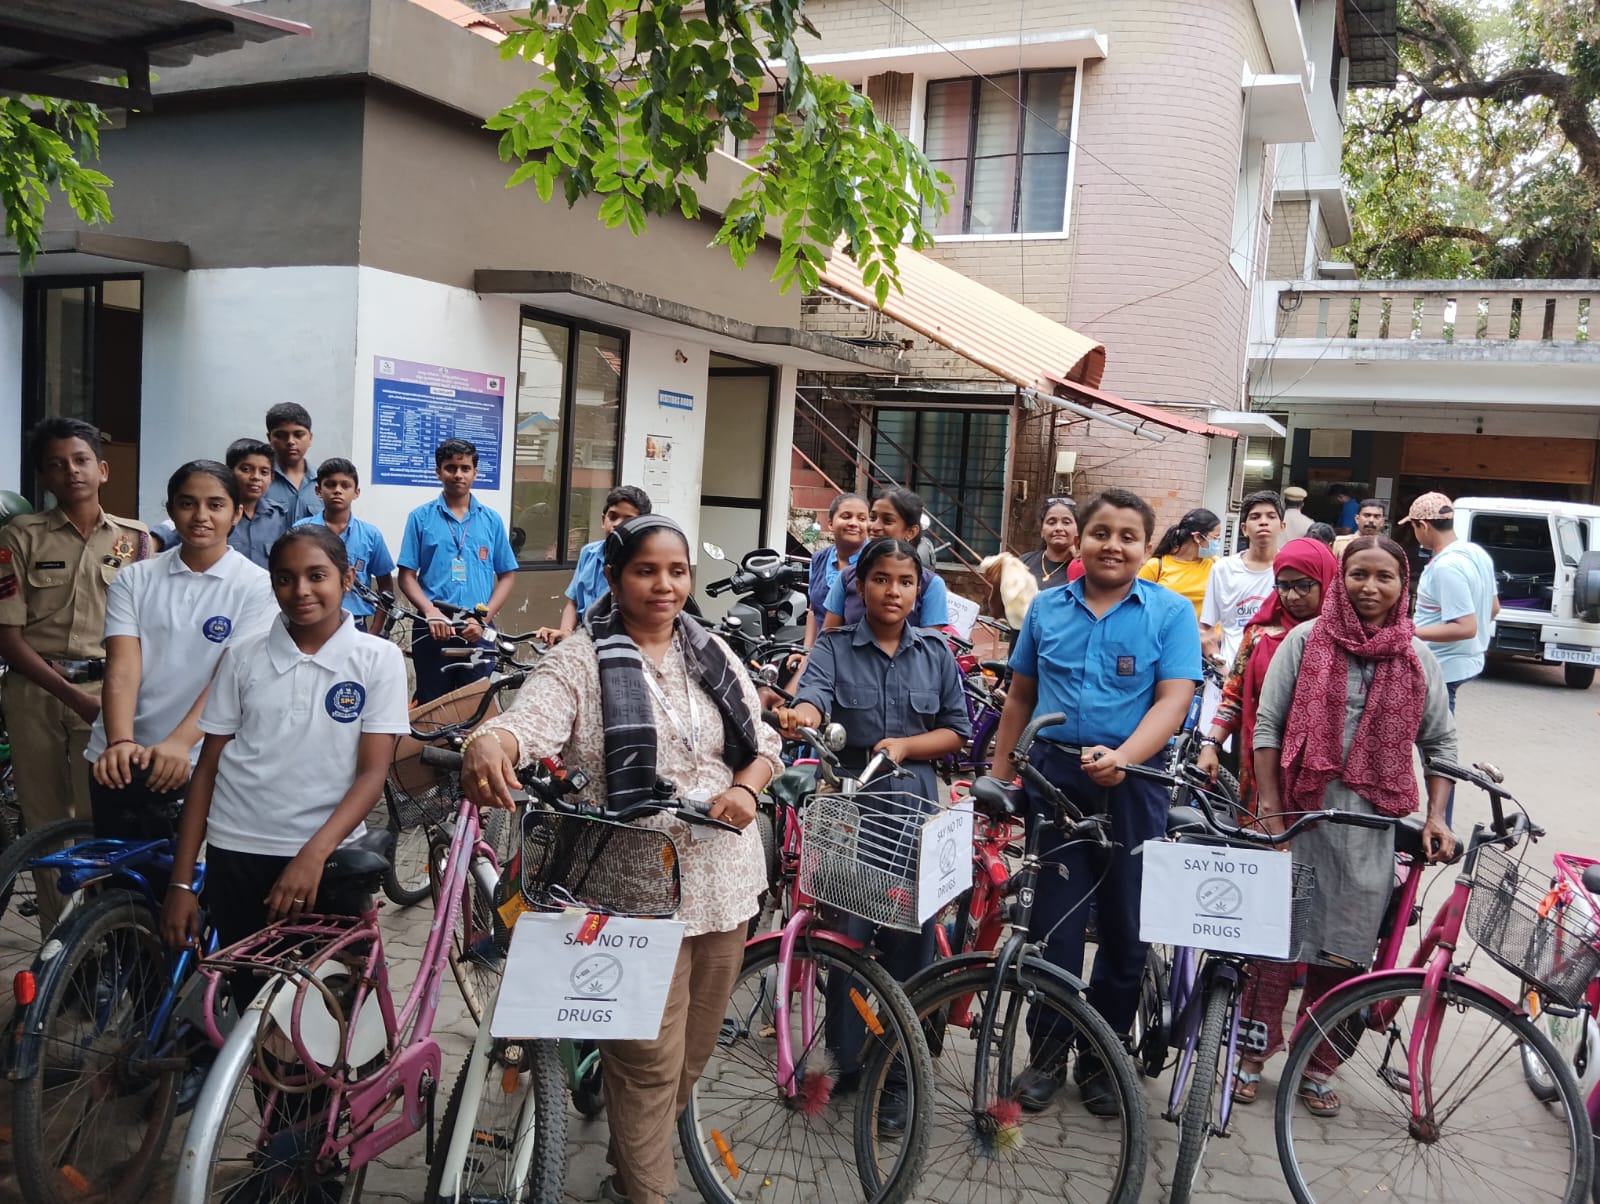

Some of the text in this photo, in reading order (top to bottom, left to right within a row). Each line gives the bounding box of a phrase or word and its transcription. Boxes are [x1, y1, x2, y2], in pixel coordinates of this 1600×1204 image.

[340, 697, 355, 705] SPC
[937, 817, 963, 841] SAY NO TO
[1184, 859, 1258, 875] SAY NO TO
[937, 878, 956, 898] DRUGS
[1192, 923, 1241, 938] DRUGS
[599, 933, 623, 948] NO
[628, 935, 648, 949] TO
[557, 1008, 613, 1023] DRUGS
